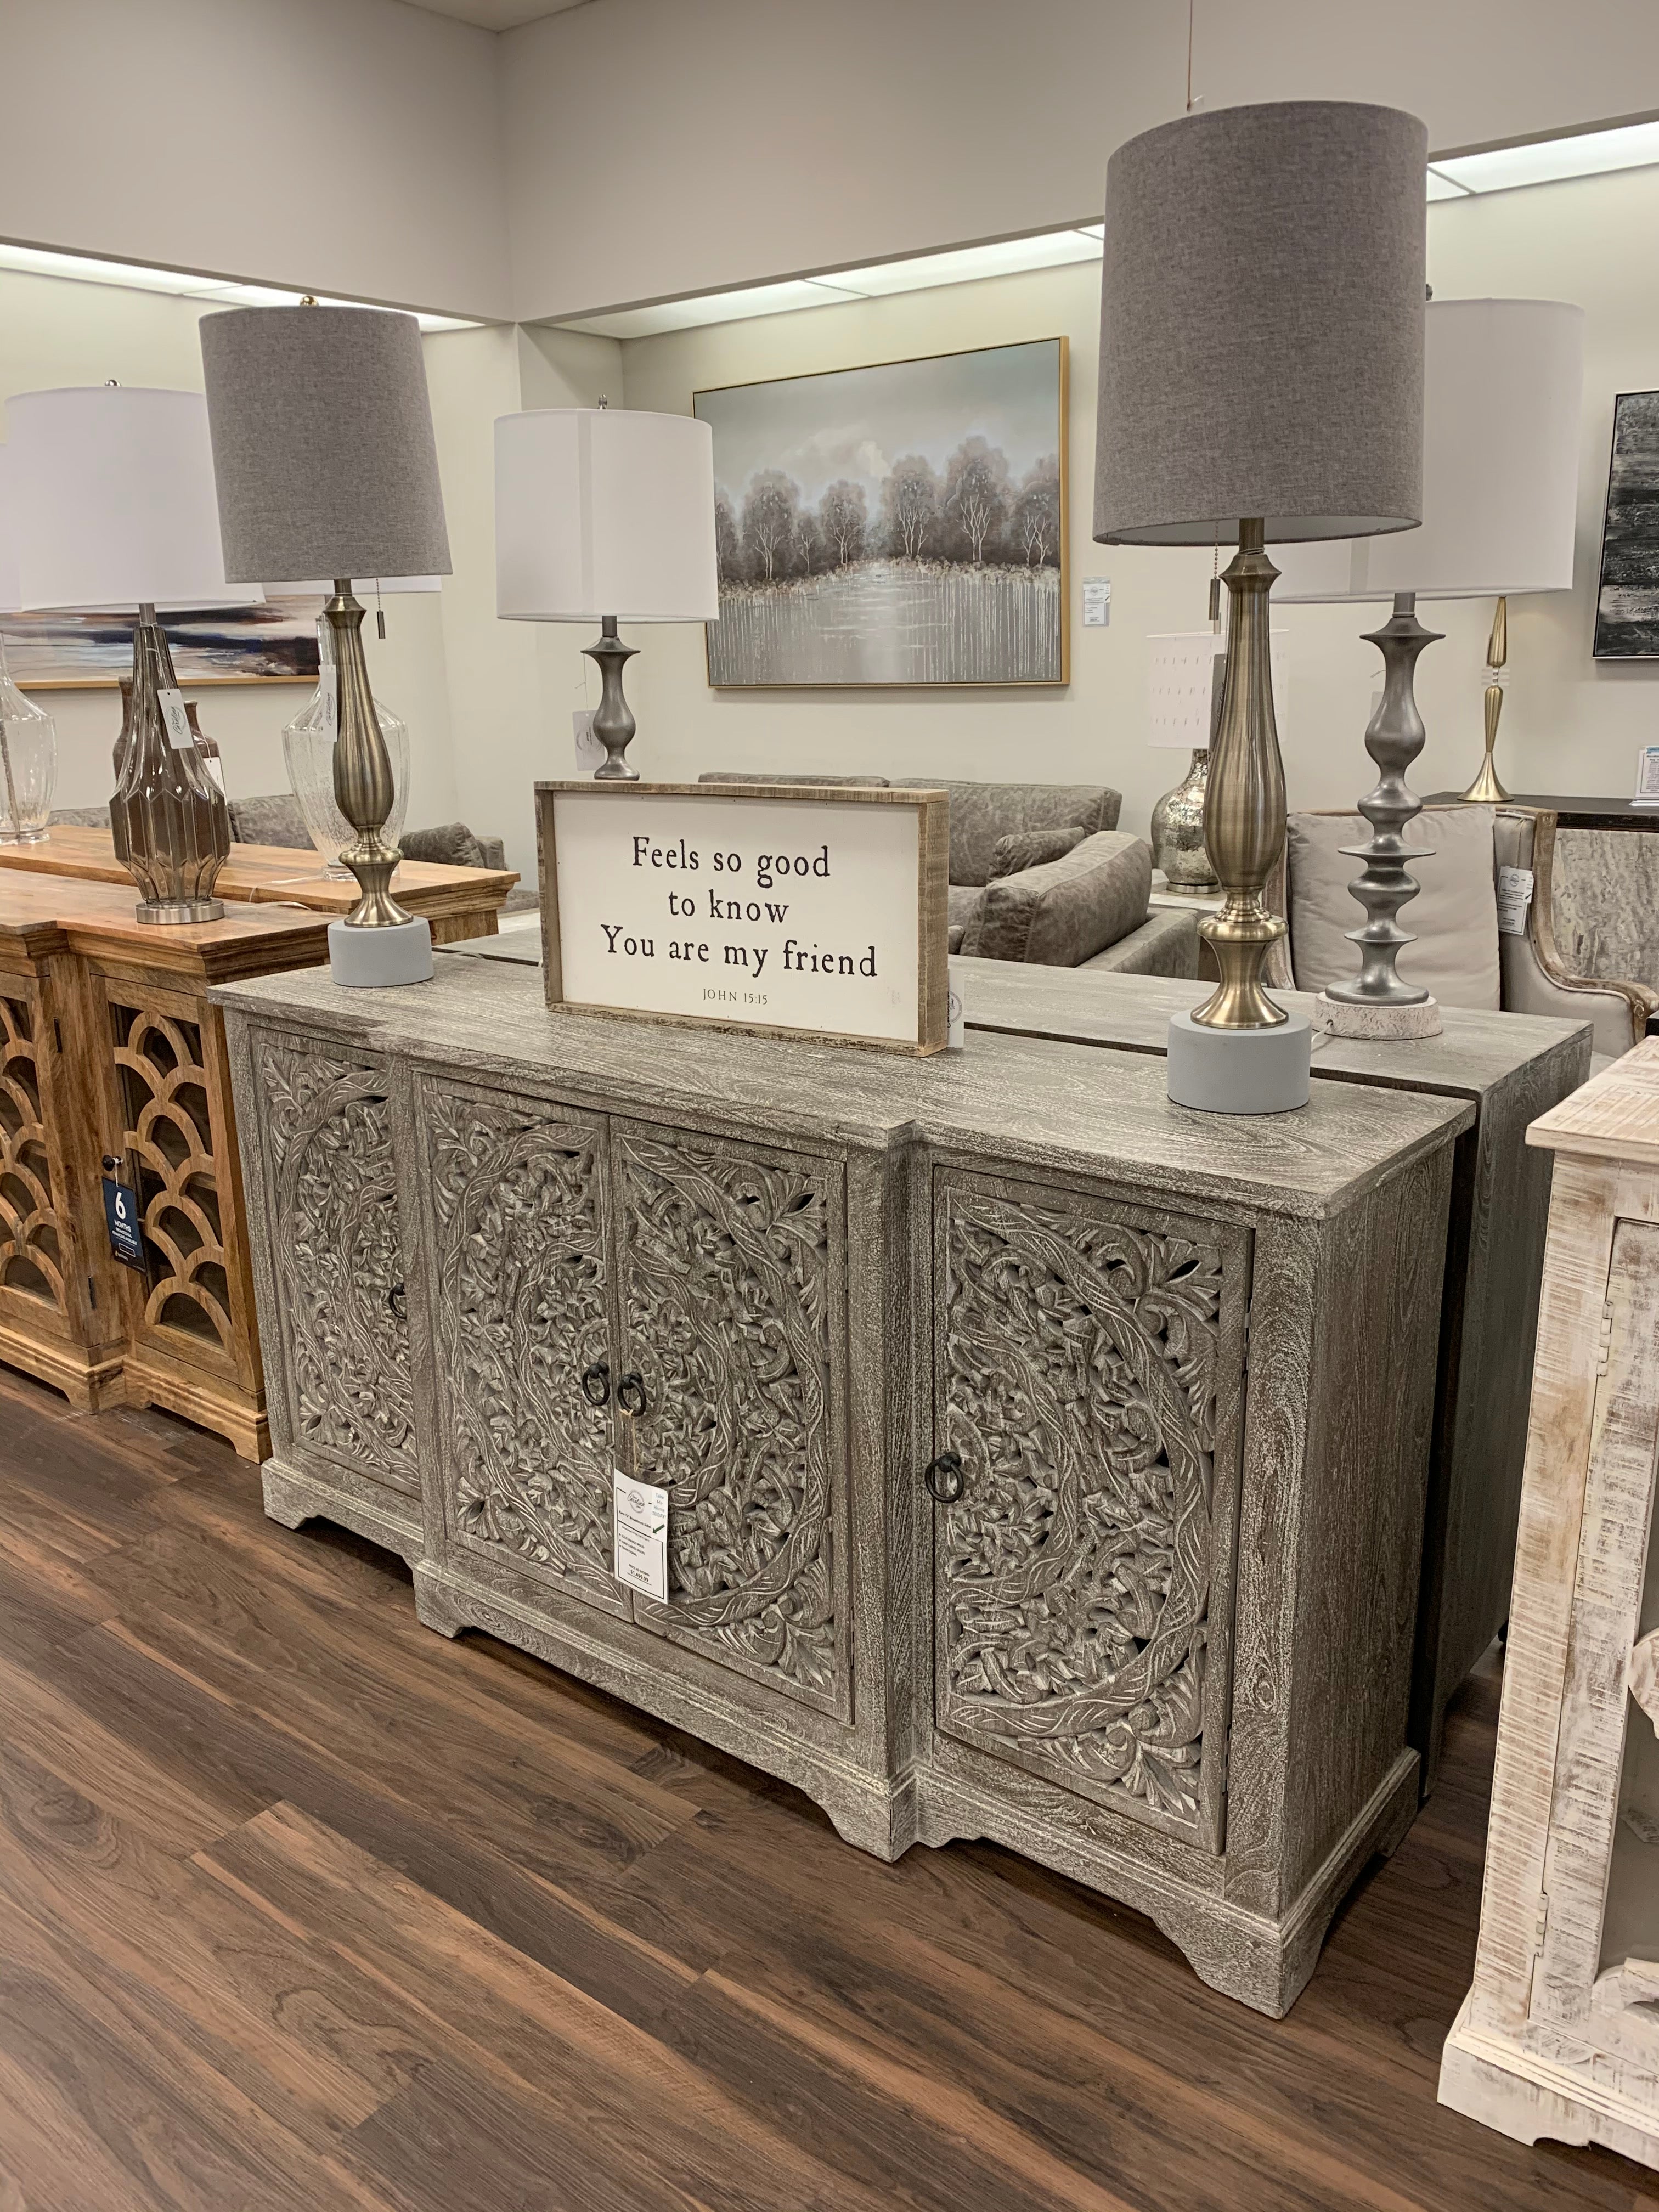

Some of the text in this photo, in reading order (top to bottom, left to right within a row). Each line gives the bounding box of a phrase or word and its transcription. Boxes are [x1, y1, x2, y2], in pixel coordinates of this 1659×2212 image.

[632, 836, 831, 889] Feels so good
[668, 888, 789, 923] to know
[600, 923, 878, 978] You are my friend
[703, 988, 768, 1005] JOHN 15:15
[115, 1192, 126, 1220] 6
